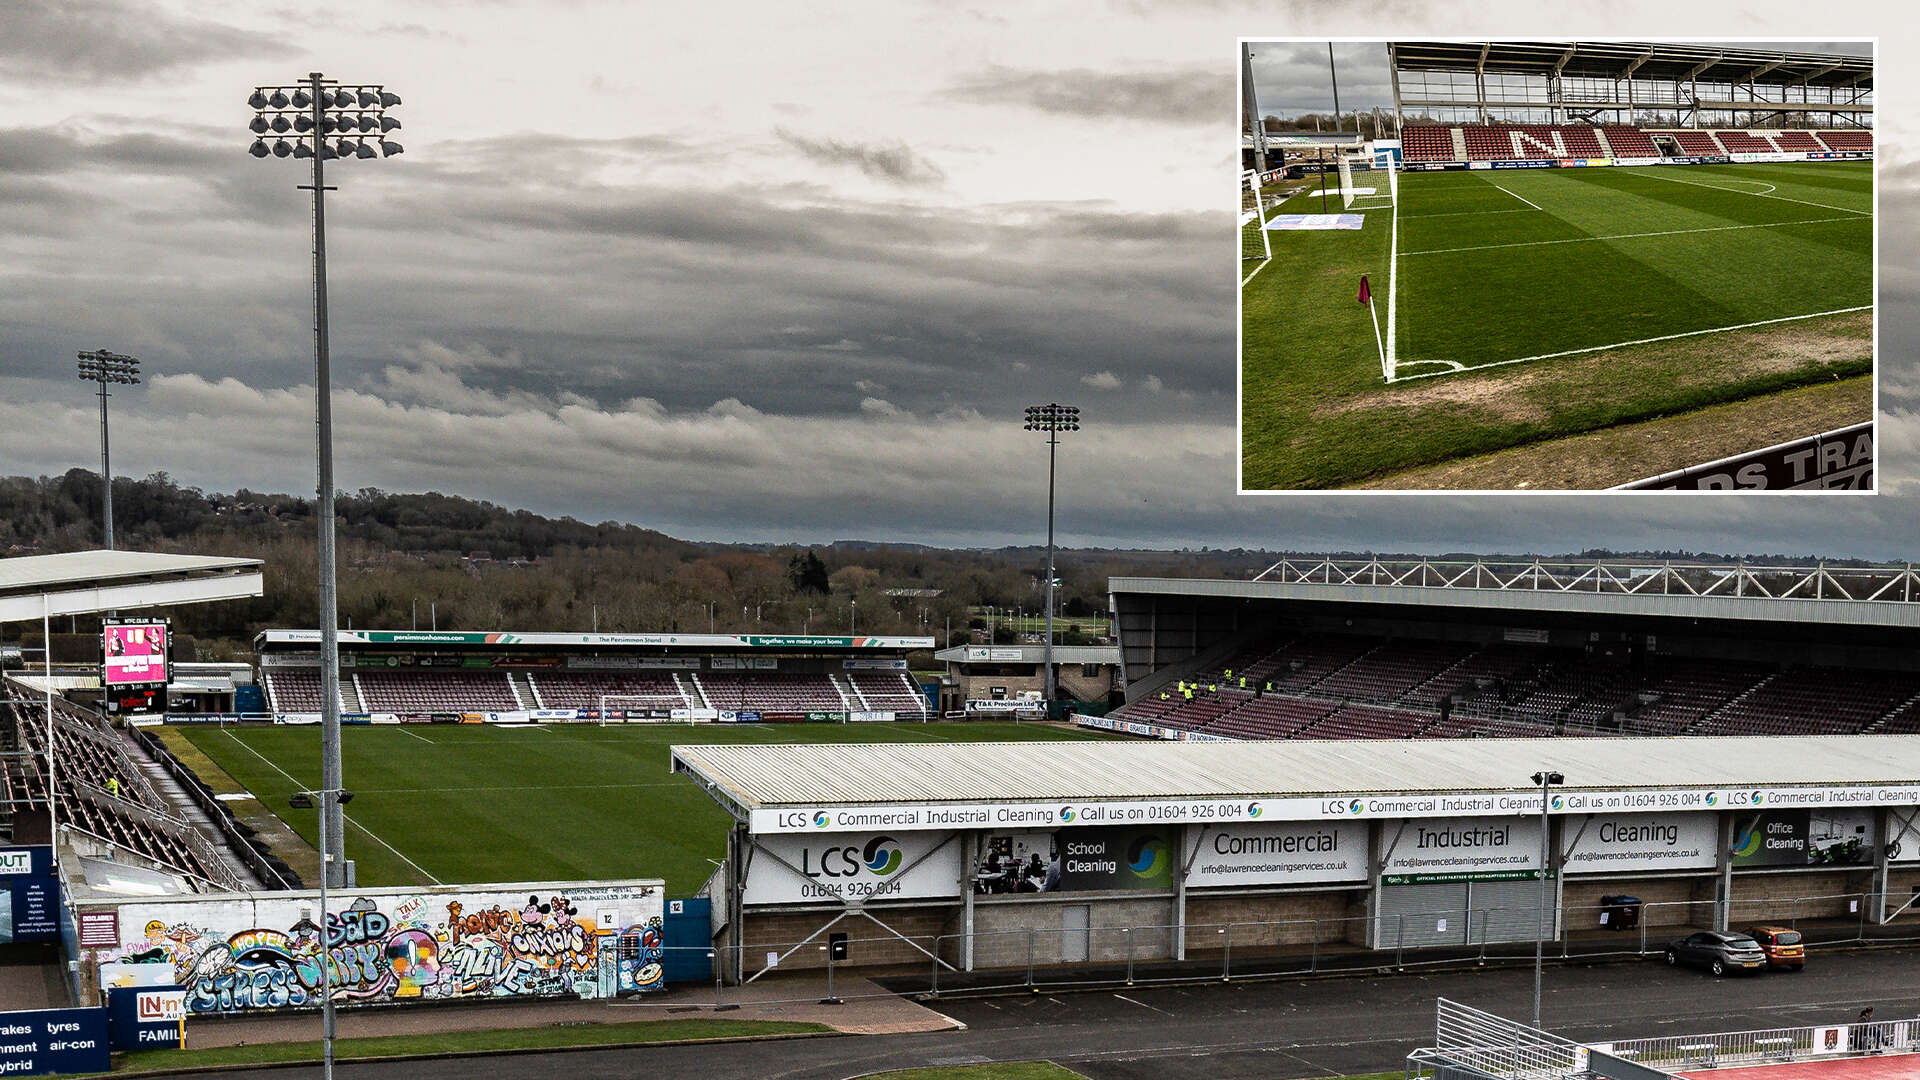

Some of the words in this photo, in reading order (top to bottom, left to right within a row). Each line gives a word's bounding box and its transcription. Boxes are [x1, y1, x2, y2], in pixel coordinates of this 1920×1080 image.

[1508, 131, 1568, 158] N
[1129, 724, 1147, 734] BRAKES
[779, 812, 807, 828] LCS
[837, 811, 919, 826] Commercial
[926, 809, 990, 824] Industrial
[997, 808, 1054, 824] Cleaning
[1080, 806, 1105, 820] Call
[1109, 809, 1124, 819] us
[1127, 808, 1144, 819] on
[1148, 805, 1187, 818] 01604
[1191, 804, 1216, 818] 926
[1218, 804, 1242, 817] 004
[1321, 801, 1345, 814] LCS
[1368, 799, 1436, 813] Commercial
[1441, 798, 1495, 811] Industrial
[1499, 796, 1546, 811] Cleaning
[1568, 795, 1588, 808] Call
[1591, 797, 1604, 808] us
[1607, 797, 1620, 807] on
[1623, 794, 1656, 807] 01604
[1659, 793, 1679, 806] 926
[1681, 792, 1701, 806] 004
[1727, 792, 1748, 806] LCS
[1767, 791, 1825, 804] Commercial
[1829, 789, 1874, 802] Industrial
[1878, 788, 1919, 803] Cleaning
[1599, 822, 1678, 846] Cleaning
[1767, 822, 1793, 834] Office
[1214, 830, 1338, 855] Commercial
[1416, 824, 1510, 849] Industrial
[1766, 837, 1804, 850] Cleaning
[1067, 842, 1106, 855] School
[1573, 848, 1700, 862] info@lawrencecleaningservices.co.uk
[802, 846, 860, 878] LCS
[1066, 859, 1117, 874] Cleaning
[1201, 860, 1348, 875] info@lawrencecleaningservices.co.uk
[1393, 854, 1530, 868] info@lawrencecleaningservices.co.uk
[801, 884, 843, 898] 01604
[847, 882, 873, 896] 926
[875, 881, 902, 895] 004
[397, 898, 421, 914] TALK
[673, 902, 681, 912] 12
[603, 914, 612, 924] 12
[191, 968, 308, 1012] STRESS
[47, 1022, 80, 1034] tyres
[50, 1040, 95, 1051] air-con
